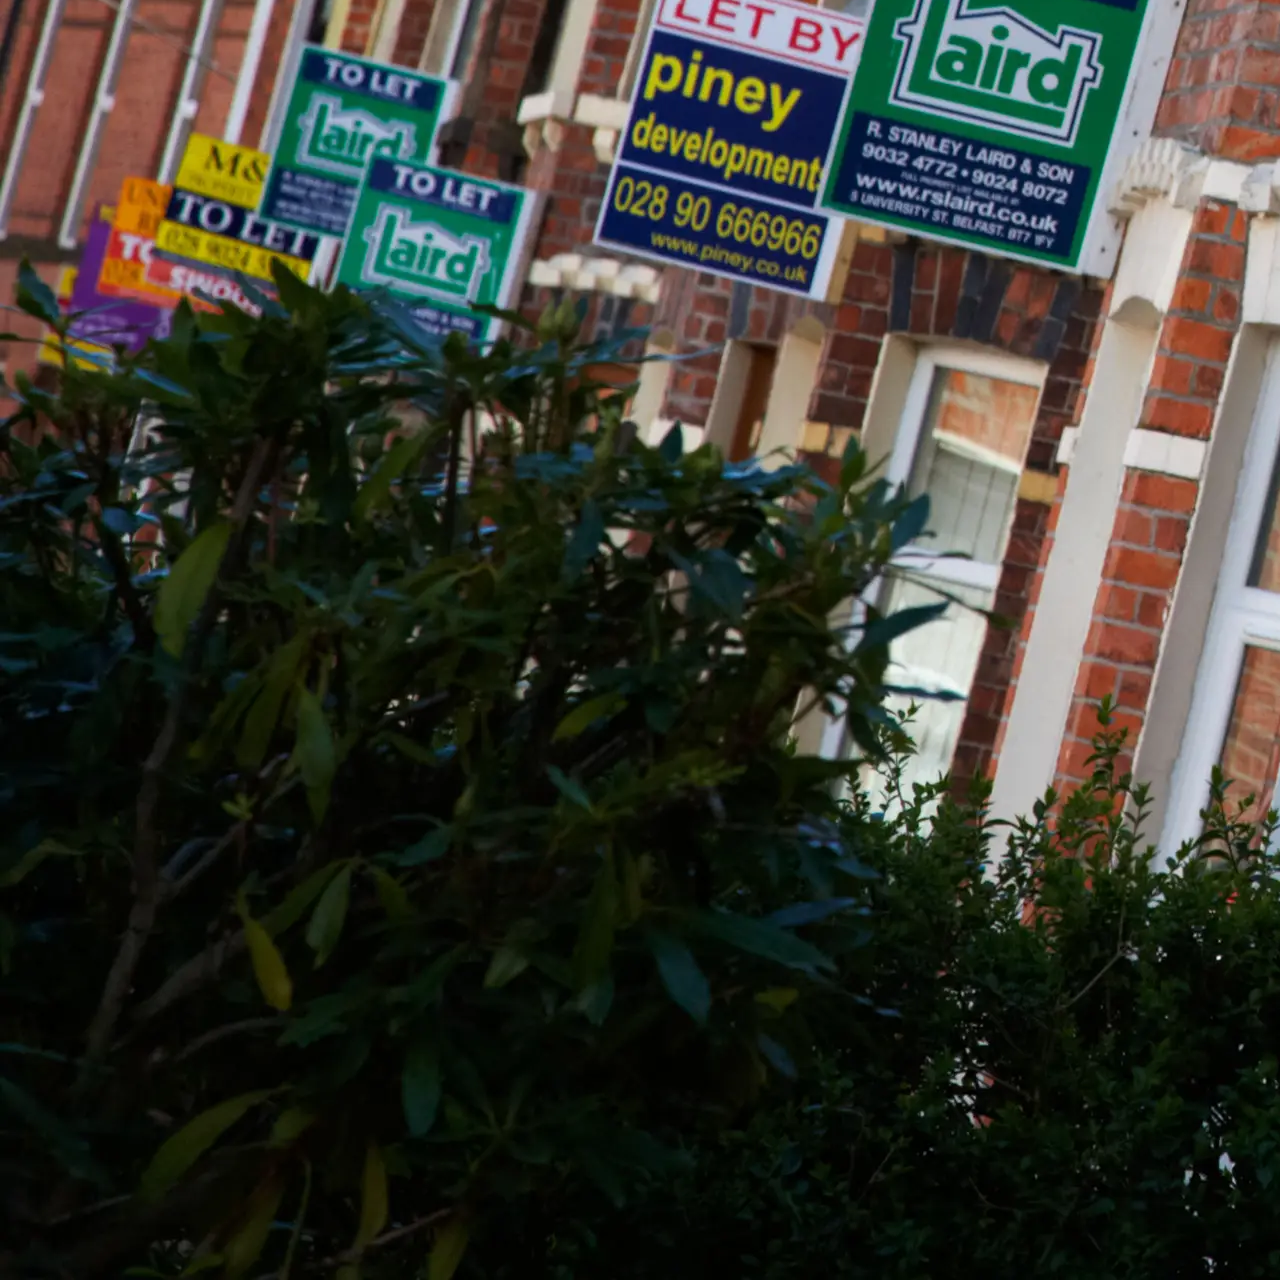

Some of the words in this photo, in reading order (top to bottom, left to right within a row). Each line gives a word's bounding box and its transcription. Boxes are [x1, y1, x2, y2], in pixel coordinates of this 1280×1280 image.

[788, 16, 861, 62] BY
[325, 58, 365, 87] TO
[369, 71, 421, 101] LET
[643, 49, 803, 133] piney
[862, 143, 910, 167] 9032
[912, 155, 958, 179] 4772
[971, 169, 1018, 193] 9024
[1022, 182, 1068, 206] 8072
[867, 120, 882, 139] R.
[888, 125, 963, 157] STANLEY
[965, 144, 1016, 170] LAIRD
[1020, 158, 1032, 174] &
[1037, 162, 1075, 185] SON
[176, 191, 233, 232] TO
[393, 163, 437, 196] TO
[442, 179, 498, 212] LET
[856, 172, 1059, 235] www.rslaird.co.uk
[614, 176, 669, 221] 028
[674, 191, 712, 232] 90
[716, 203, 822, 260] 666966
[860, 191, 930, 220] UNIVERSITY
[1007, 228, 1031, 244] BT7
[651, 231, 808, 284] www.piney.co.uk
